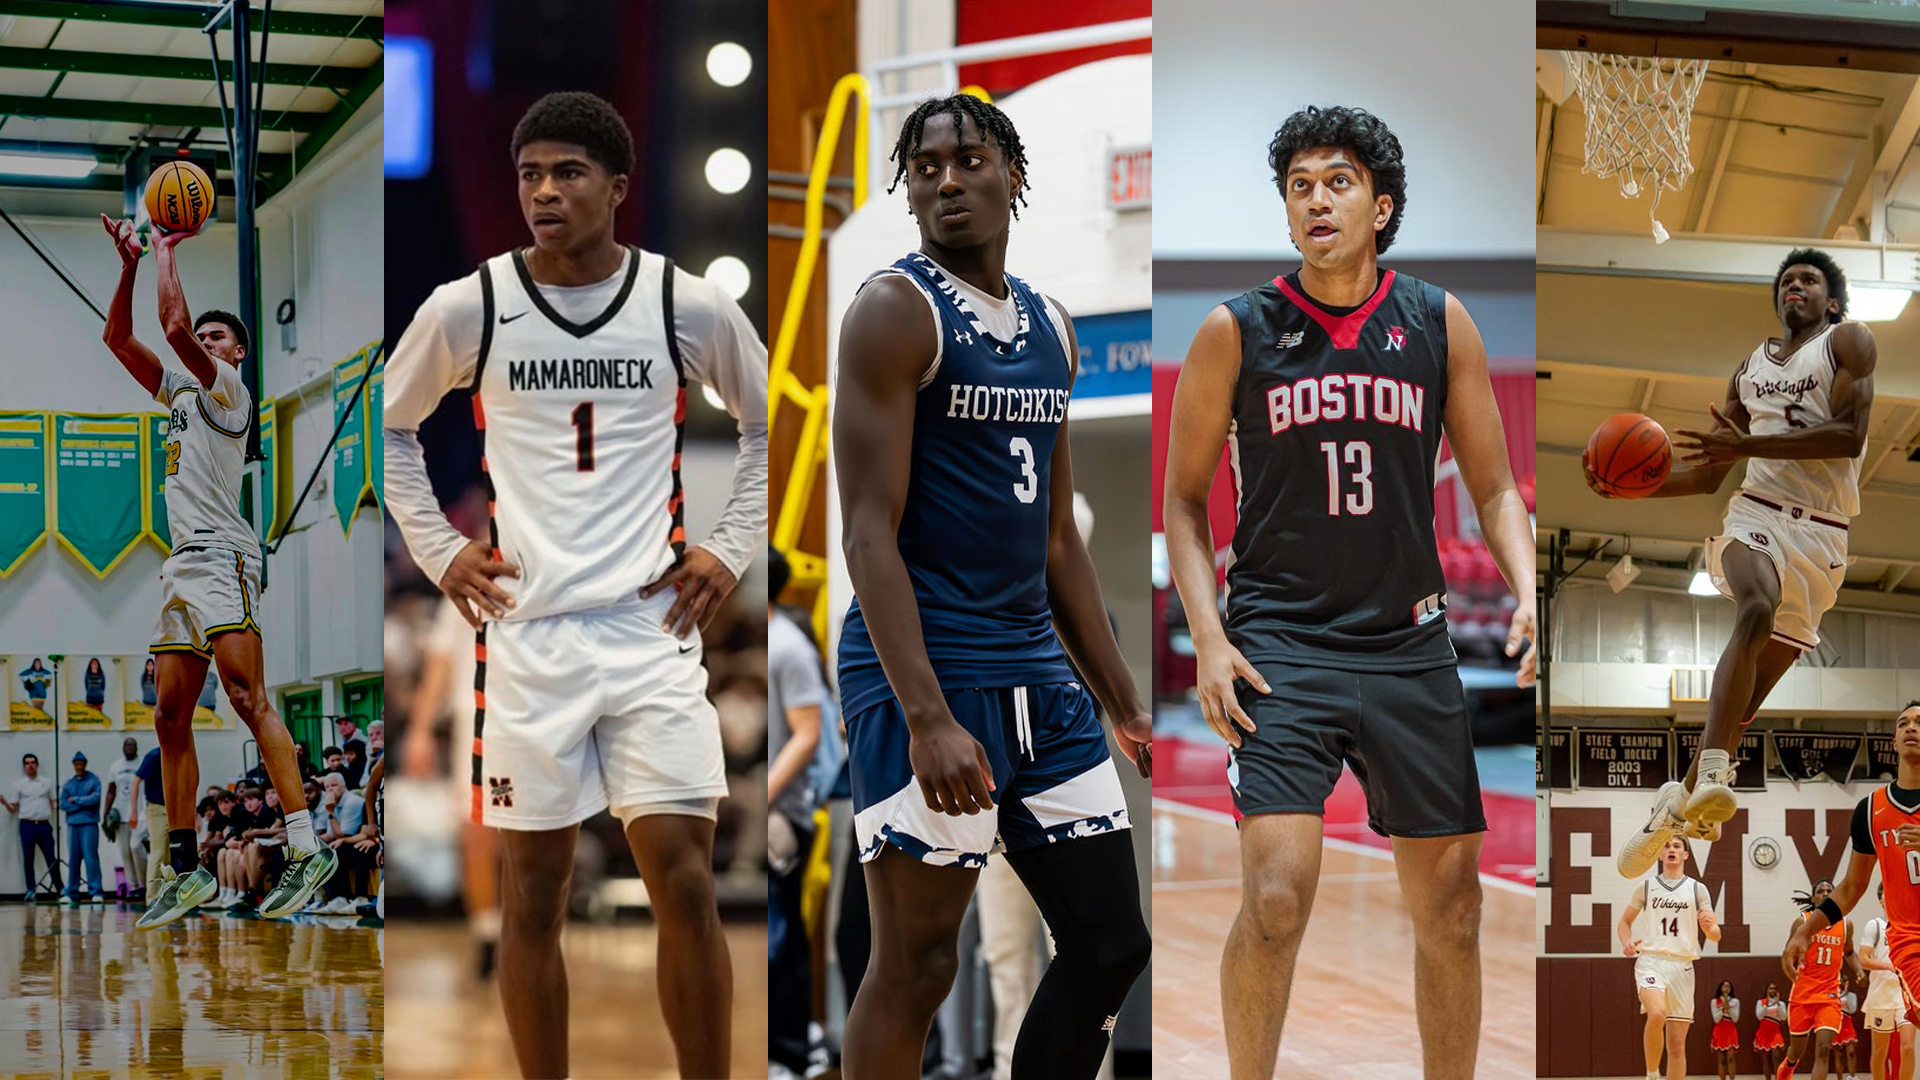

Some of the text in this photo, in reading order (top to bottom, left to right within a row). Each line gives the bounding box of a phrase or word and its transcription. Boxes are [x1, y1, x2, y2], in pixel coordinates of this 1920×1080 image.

[167, 193, 180, 225] NCAA
[509, 359, 653, 391] MAMARONECK
[1267, 373, 1425, 434] BOSTON
[571, 401, 595, 472] 1
[1009, 437, 1038, 504] 3
[1320, 441, 1374, 516] 13
[1586, 735, 1663, 747] STATE CHAMPION
[1682, 735, 1703, 747] STA
[1779, 738, 1804, 748] STATE
[1873, 740, 1894, 751] STAT
[1591, 748, 1657, 760] FIELD HOCKEY
[1877, 752, 1897, 765] FIEL
[1608, 761, 1641, 773] 2003
[1608, 774, 1631, 786] DIV.
[1652, 897, 1689, 913] Vikings
[1661, 917, 1679, 937] 14
[1817, 946, 1832, 966] 11
